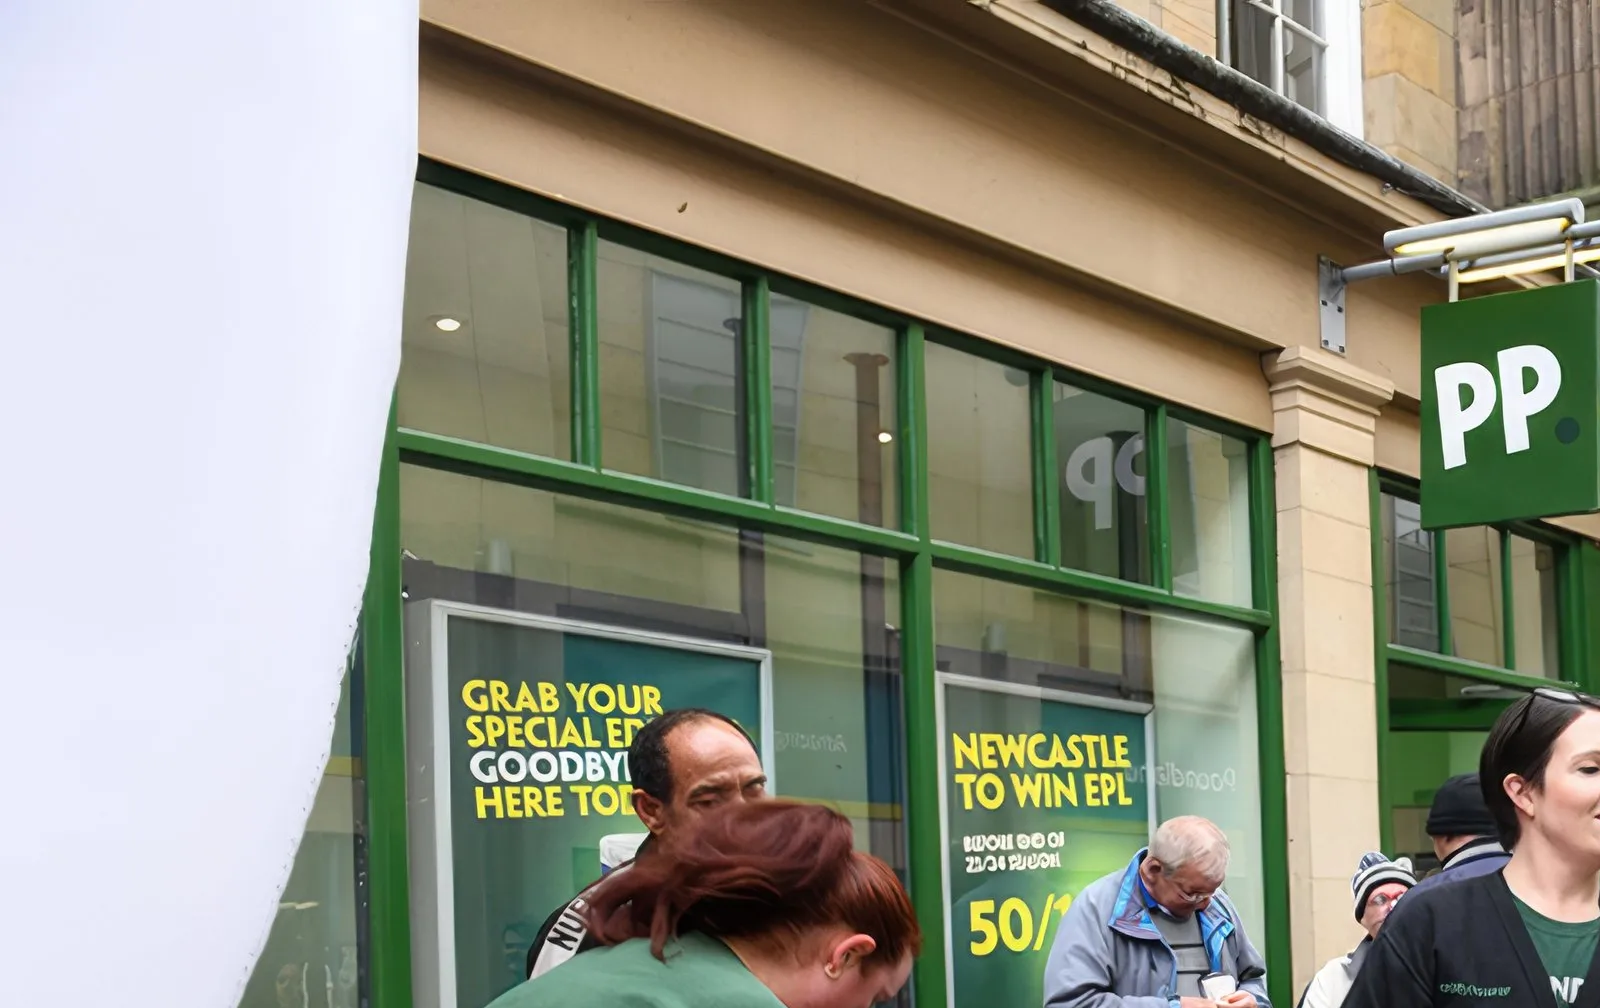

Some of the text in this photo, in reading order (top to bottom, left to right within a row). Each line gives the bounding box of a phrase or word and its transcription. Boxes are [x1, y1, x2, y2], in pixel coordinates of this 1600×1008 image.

[461, 679, 664, 715] GRAB YOUR
[465, 714, 601, 749] SPECIAL
[952, 732, 1132, 770] NEWCASTLE
[475, 785, 565, 819] HERE
[954, 771, 1133, 810] TO WIN EPL
